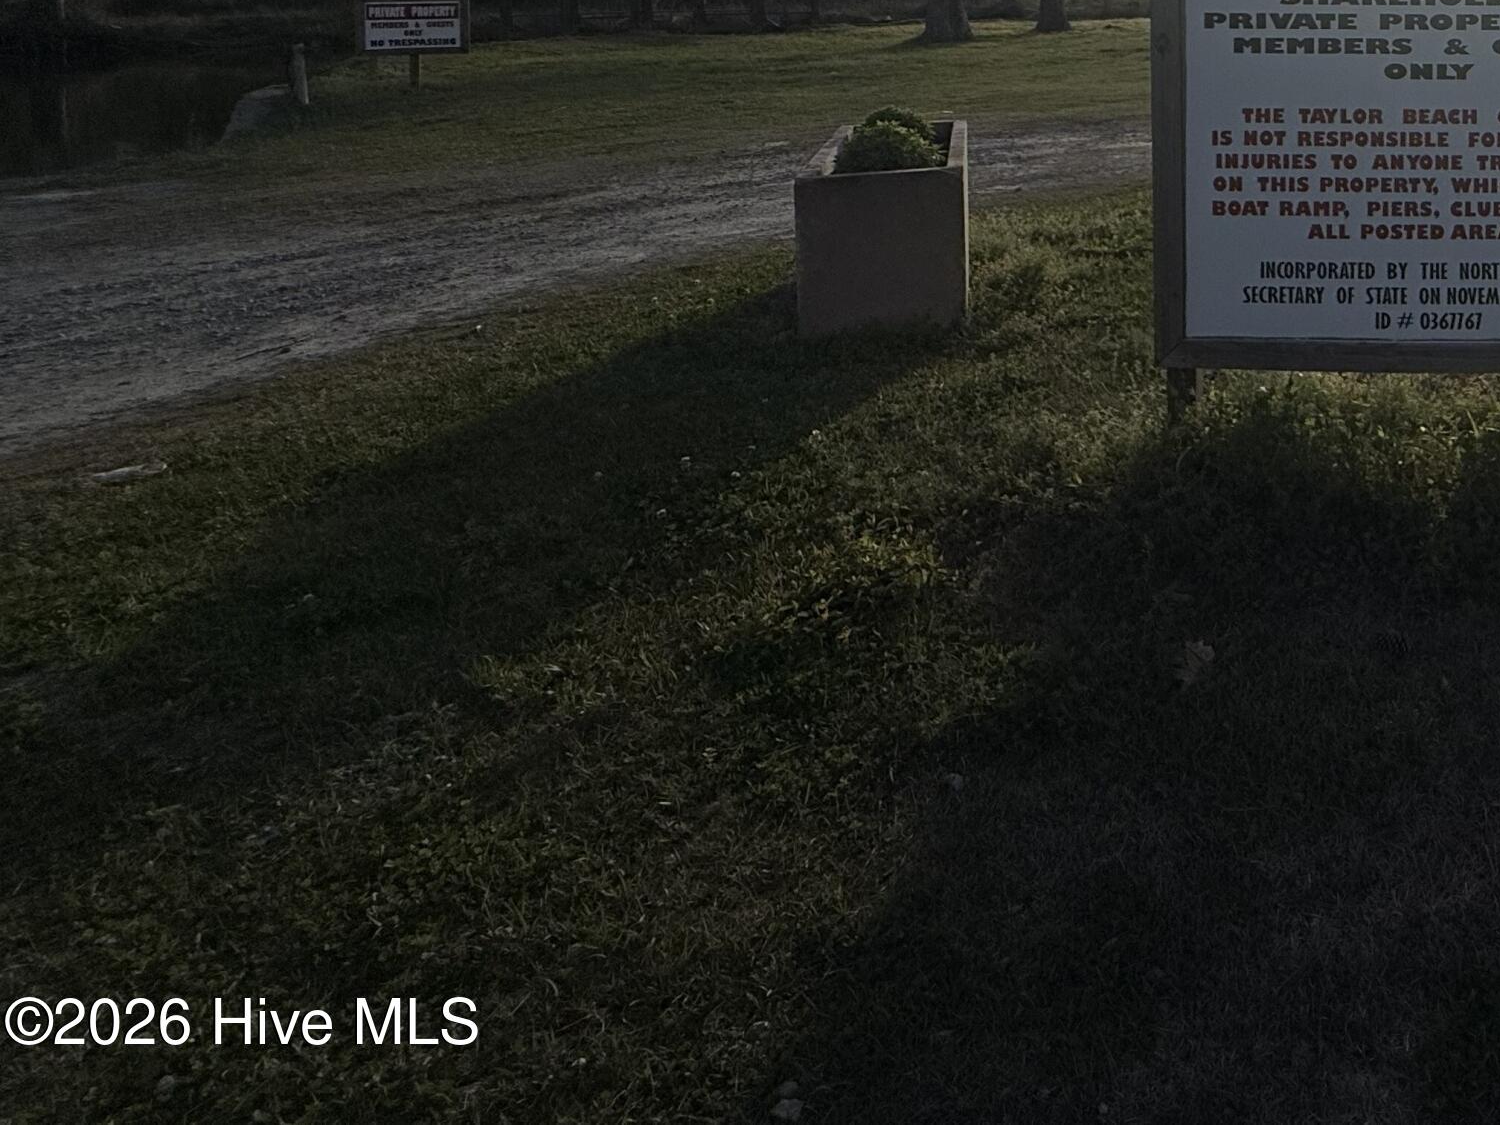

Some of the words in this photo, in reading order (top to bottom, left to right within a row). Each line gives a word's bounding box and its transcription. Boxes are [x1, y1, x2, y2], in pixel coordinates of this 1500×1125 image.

[1204, 13, 1357, 29] PRIVATE
[1234, 38, 1412, 54] MEMBERS
[1444, 39, 1468, 55] &
[1384, 64, 1474, 80] ONLY
[1242, 108, 1284, 123] THE
[1299, 109, 1382, 124] TAYLOR
[1403, 109, 1477, 124] BEACH
[1212, 131, 1232, 145] IS
[1244, 131, 1286, 146] NOT
[1298, 131, 1448, 147] RESPONSIBLE
[1216, 154, 1316, 169] INJURIES
[1331, 154, 1357, 170] TO
[1372, 155, 1462, 170] ANYONE
[1213, 177, 1242, 191] ON
[1258, 177, 1308, 192] THIS
[1320, 177, 1438, 195] PROPERTY,
[1213, 201, 1269, 216] BOAT
[1280, 201, 1349, 218] RAMP,
[1368, 202, 1439, 218] PIERS,
[1308, 224, 1350, 239] ALL
[1361, 224, 1444, 239] POSTED
[1261, 262, 1375, 279] INCORPORATED
[1388, 263, 1407, 279] BY
[1421, 263, 1447, 279] THE
[1243, 286, 1324, 303] SECRETARY
[1337, 287, 1354, 304] OF
[1367, 287, 1407, 304] STATE
[1420, 288, 1440, 304] ON
[1376, 312, 1391, 329] ID
[1398, 313, 1413, 328] #
[1421, 313, 1482, 329] 0367767
